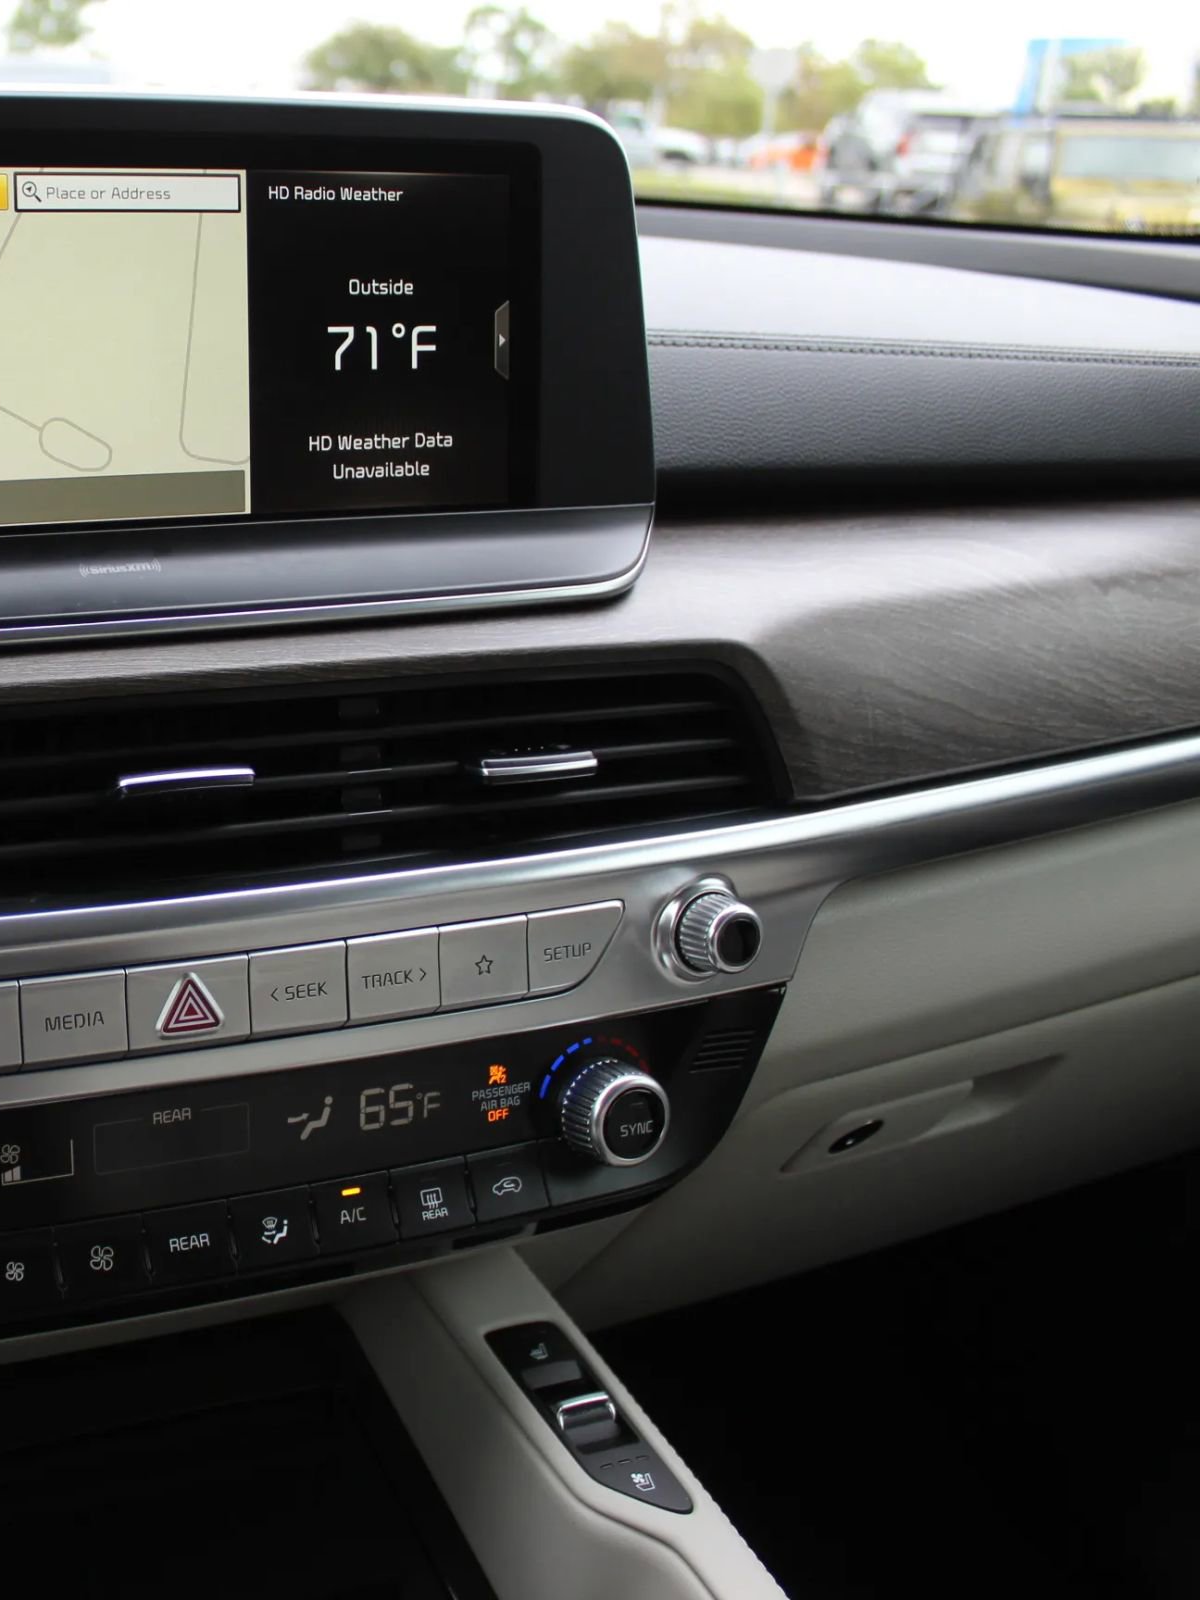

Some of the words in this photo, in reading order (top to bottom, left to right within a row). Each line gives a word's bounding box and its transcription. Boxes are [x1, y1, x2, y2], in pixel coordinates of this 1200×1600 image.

[46, 187, 86, 200] Place
[90, 189, 106, 200] or
[111, 187, 171, 200] Address
[268, 186, 290, 200] HD
[294, 186, 336, 200] Radio
[340, 187, 403, 202] Weather
[348, 278, 414, 295] Outside
[327, 322, 437, 371] 71°F
[308, 436, 332, 451] HD
[338, 433, 410, 450] Weather
[415, 432, 454, 448] Data
[333, 461, 430, 480] Unavailable
[543, 942, 592, 963] SETUP
[361, 968, 414, 990] TRACK
[284, 981, 328, 1000] SEEK
[44, 1011, 105, 1033] MEDIA
[471, 1081, 532, 1102] PASSENGER
[480, 1099, 498, 1112] AIR
[500, 1095, 521, 1108] BAG
[153, 1107, 192, 1125] REAR
[487, 1107, 510, 1122] OFF
[619, 1119, 654, 1138] SYNC
[340, 1206, 367, 1225] A/C
[421, 1207, 449, 1221] REAR
[169, 1233, 211, 1253] REAR
